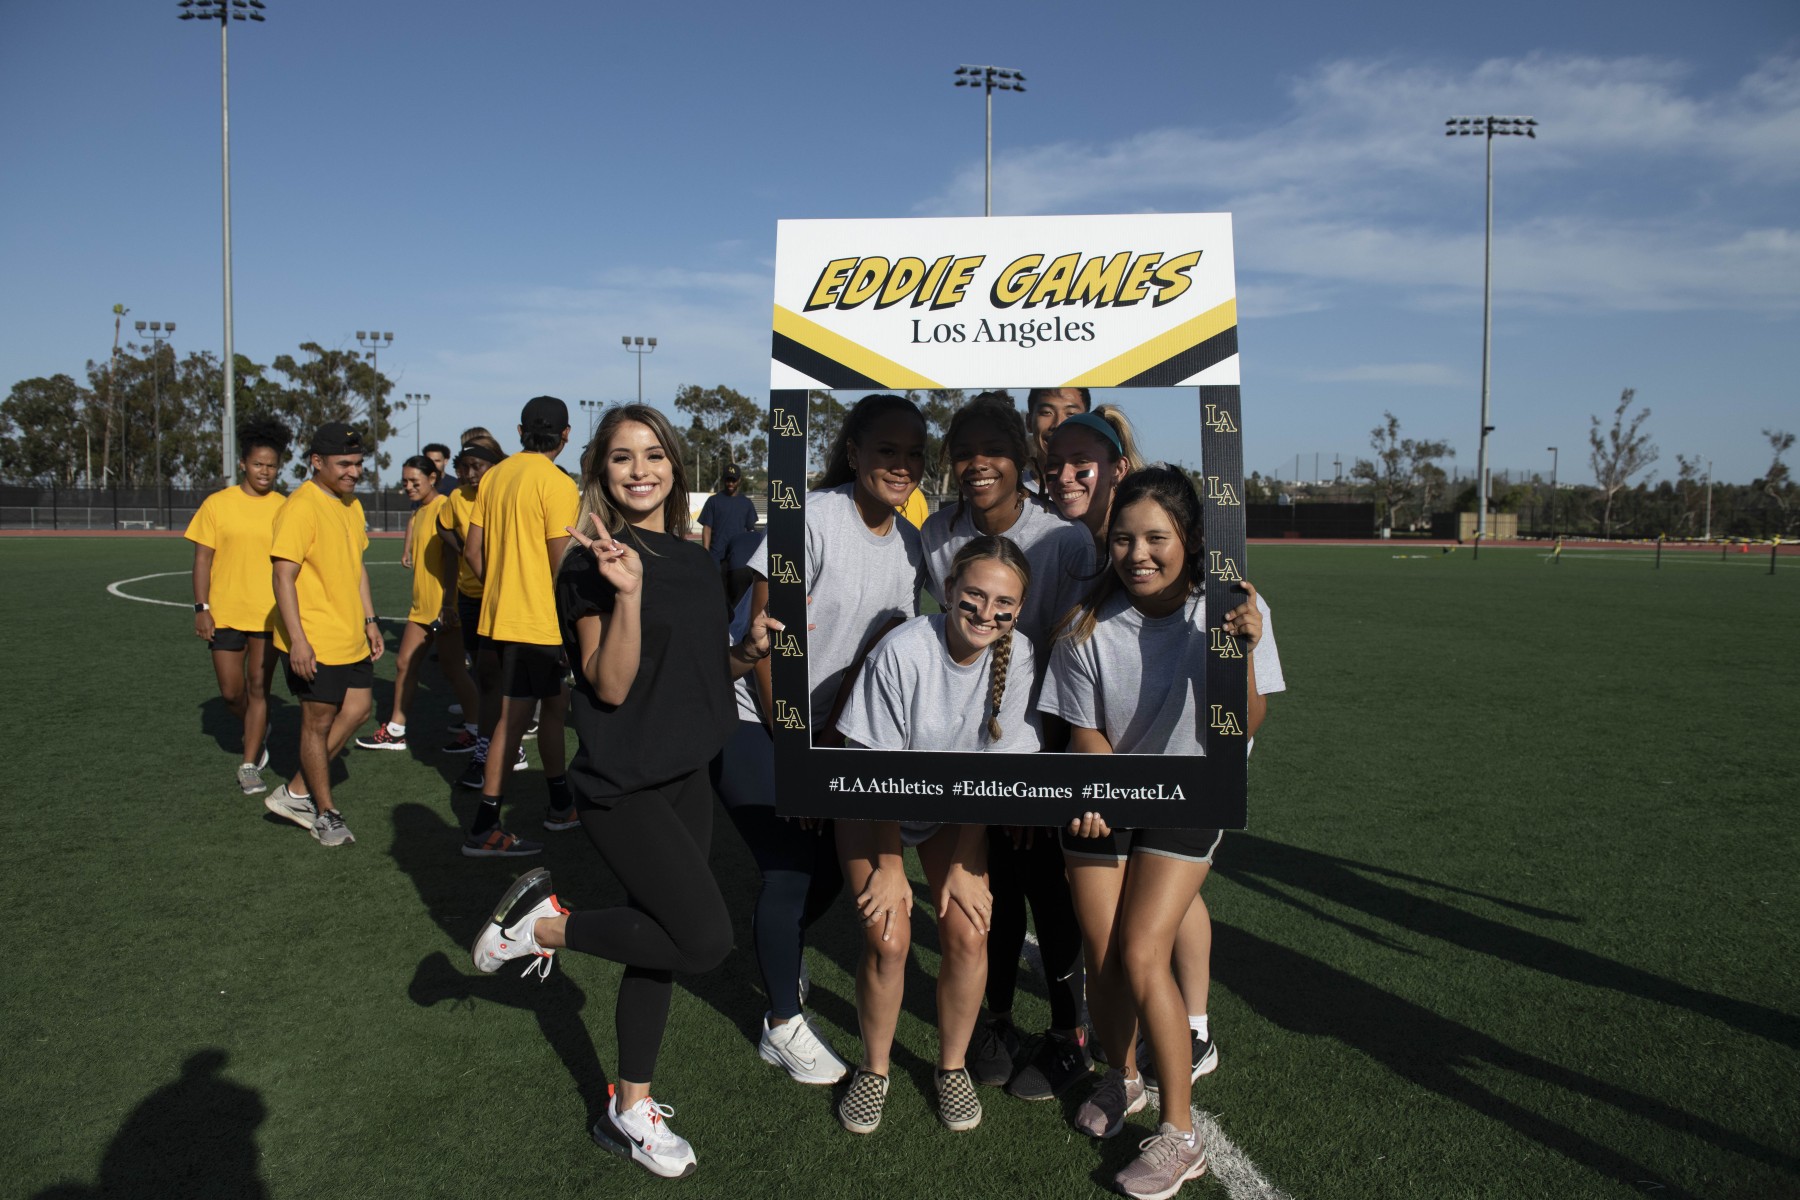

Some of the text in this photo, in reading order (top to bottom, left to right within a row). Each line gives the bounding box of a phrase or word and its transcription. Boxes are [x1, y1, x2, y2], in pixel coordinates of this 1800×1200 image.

[802, 249, 1204, 312] EDDIE GAMES
[910, 316, 1096, 348] Los Angeles
[773, 408, 803, 436] LA
[1205, 404, 1237, 432] LA
[771, 480, 801, 509] LA
[1208, 476, 1240, 505] LA
[771, 554, 801, 583] LA
[1210, 551, 1242, 582] LA
[1210, 628, 1243, 658] LA
[776, 700, 805, 729] LA
[1210, 704, 1243, 735] LA
[829, 776, 1186, 800] #LAAthletics #EddieGames #ElevateLA
